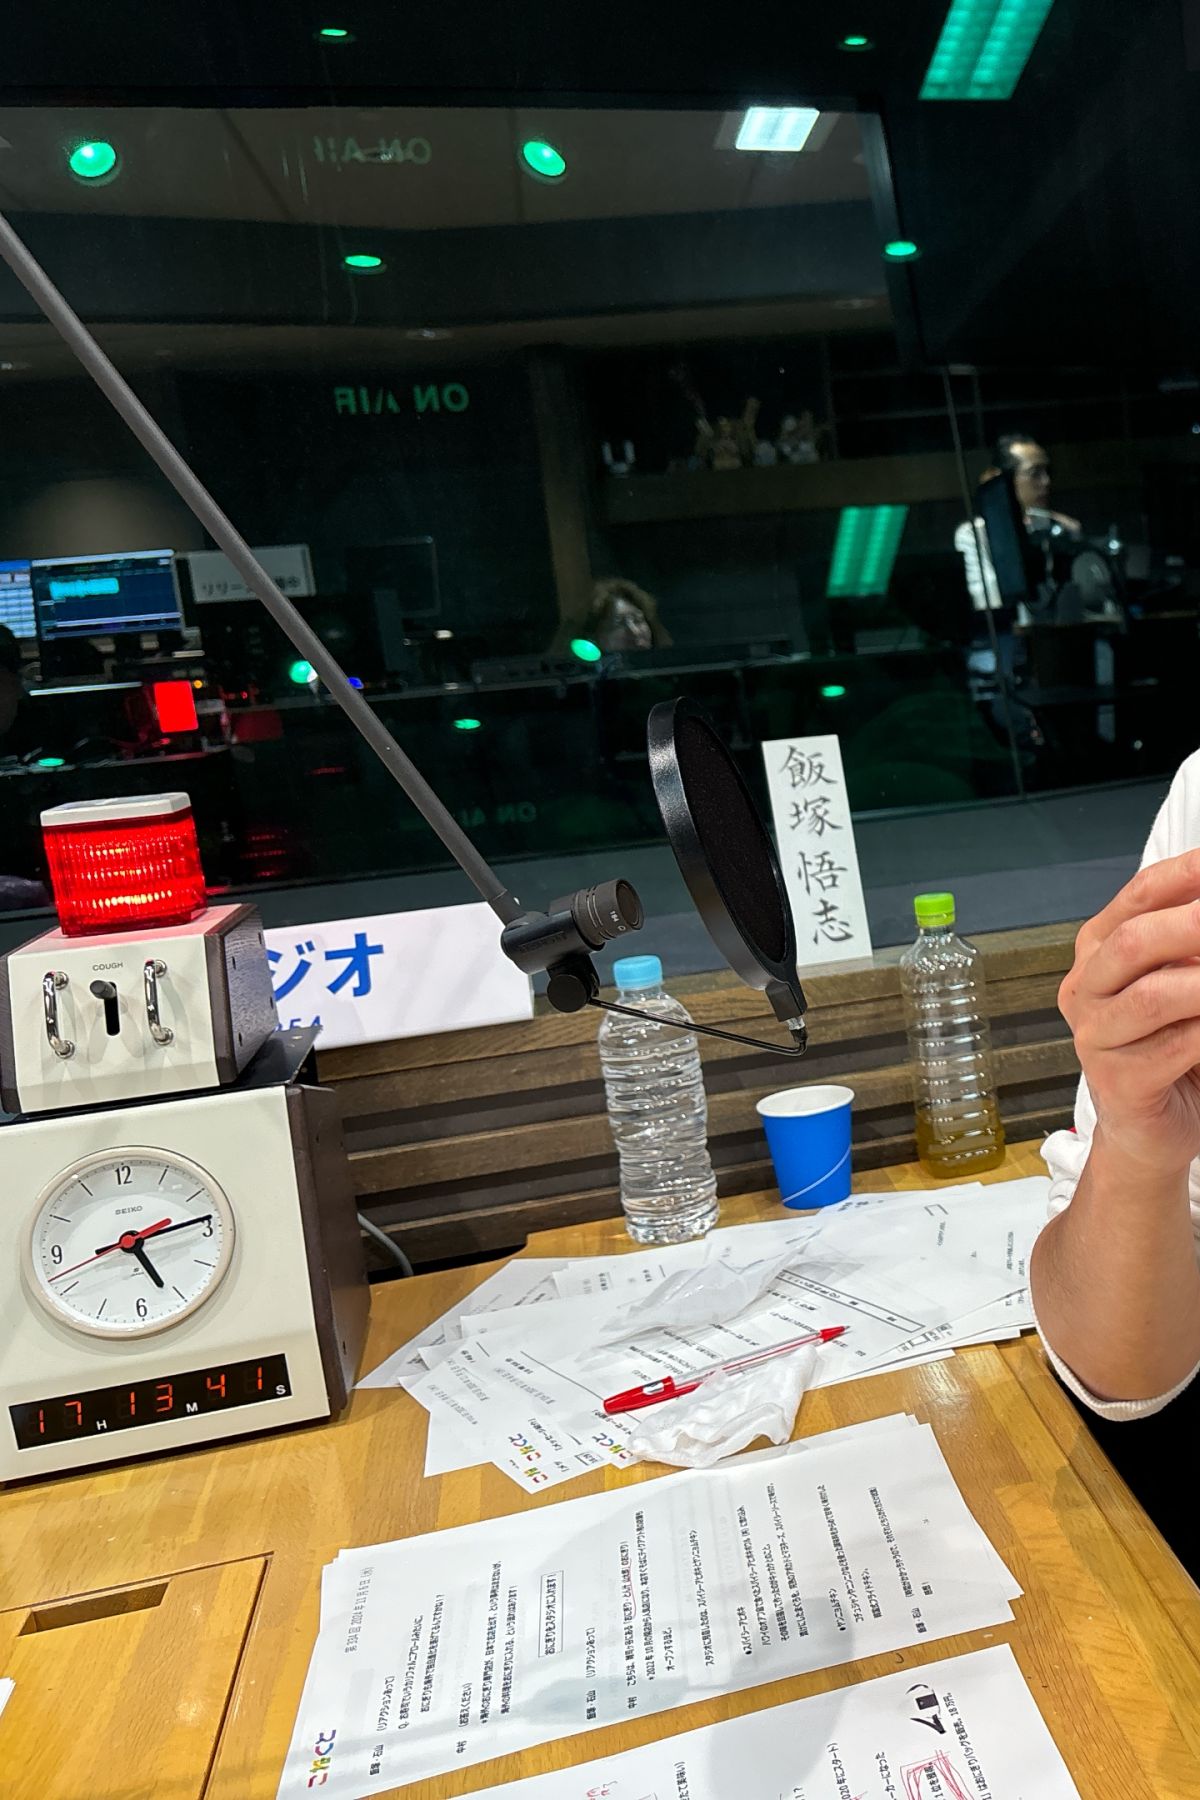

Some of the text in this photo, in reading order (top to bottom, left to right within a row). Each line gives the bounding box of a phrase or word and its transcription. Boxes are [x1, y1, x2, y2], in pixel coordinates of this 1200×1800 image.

[779, 744, 853, 946] 飯塚悟志
[92, 962, 124, 971] COUGH
[115, 1166, 133, 1186] 12
[115, 1205, 143, 1215] SEIKO
[203, 1219, 213, 1238] 3
[51, 1245, 64, 1265] 9
[136, 1297, 148, 1318] 6
[96, 1420, 107, 1430] H
[186, 1402, 198, 1413] M
[276, 1384, 286, 1394] S
[508, 1433, 541, 1461] こねくと
[308, 1729, 336, 1788] こねくと
[875, 1752, 897, 1800] ーカーになった
